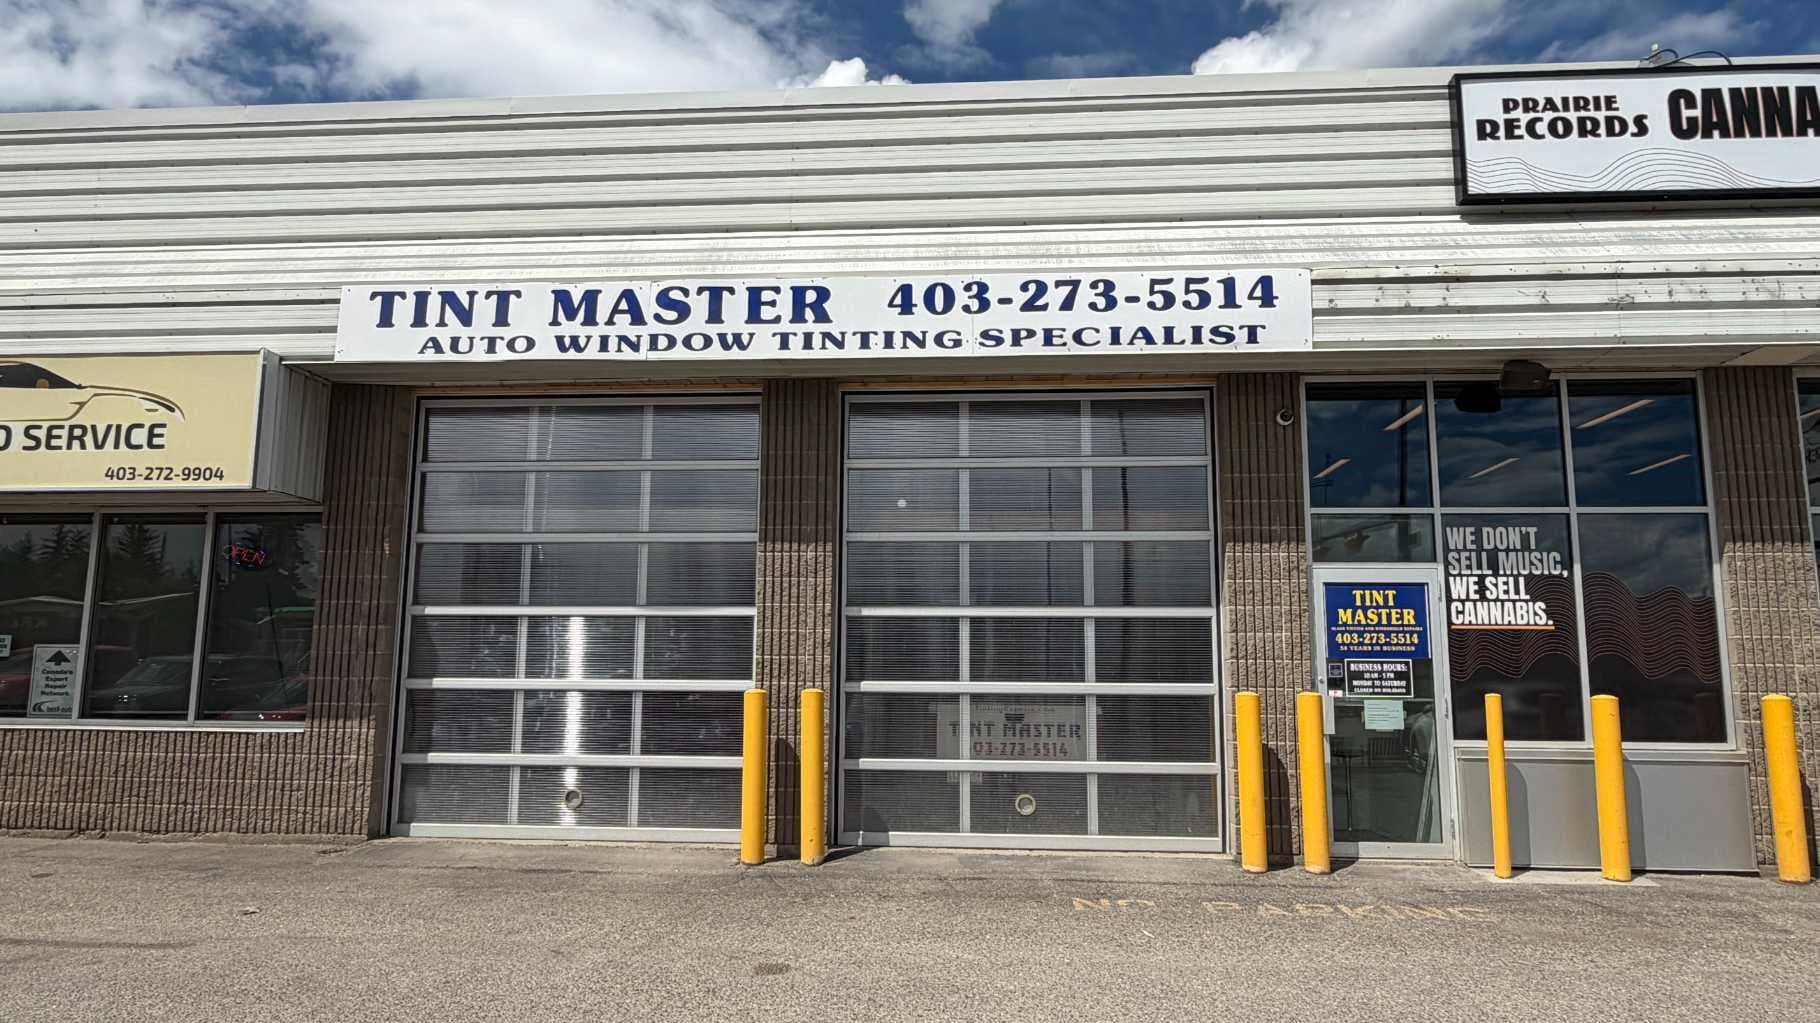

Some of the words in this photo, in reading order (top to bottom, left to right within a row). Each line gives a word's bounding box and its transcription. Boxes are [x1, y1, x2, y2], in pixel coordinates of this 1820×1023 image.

[1502, 95, 1620, 115] PRAIRIE
[1476, 114, 1649, 141] RECORDS
[369, 289, 522, 328] TINT
[548, 285, 832, 327] MASTER
[888, 275, 1279, 316] 403-273-5514
[417, 335, 536, 355] AUTO
[556, 331, 756, 354] WINDOW
[771, 329, 964, 351] TINTING
[978, 324, 1267, 349] SPECIALIST
[22, 422, 167, 451] SERVICE
[104, 466, 225, 482] 403-272-9904
[1446, 526, 1477, 550] WE
[1482, 526, 1537, 550] DON'T
[1448, 551, 1492, 575] SELL
[1498, 551, 1568, 578] MUSIC,
[1352, 590, 1397, 606] TINT
[1449, 576, 1480, 600] WE
[1485, 576, 1531, 600] SELL
[1337, 608, 1416, 625] MASTER
[1450, 601, 1554, 625] CANNABIS.
[1335, 633, 1419, 644] 403-273-5514
[1350, 663, 1382, 671] BUSINESS
[948, 722, 995, 738] TNT
[1003, 722, 1081, 741] MASTER
